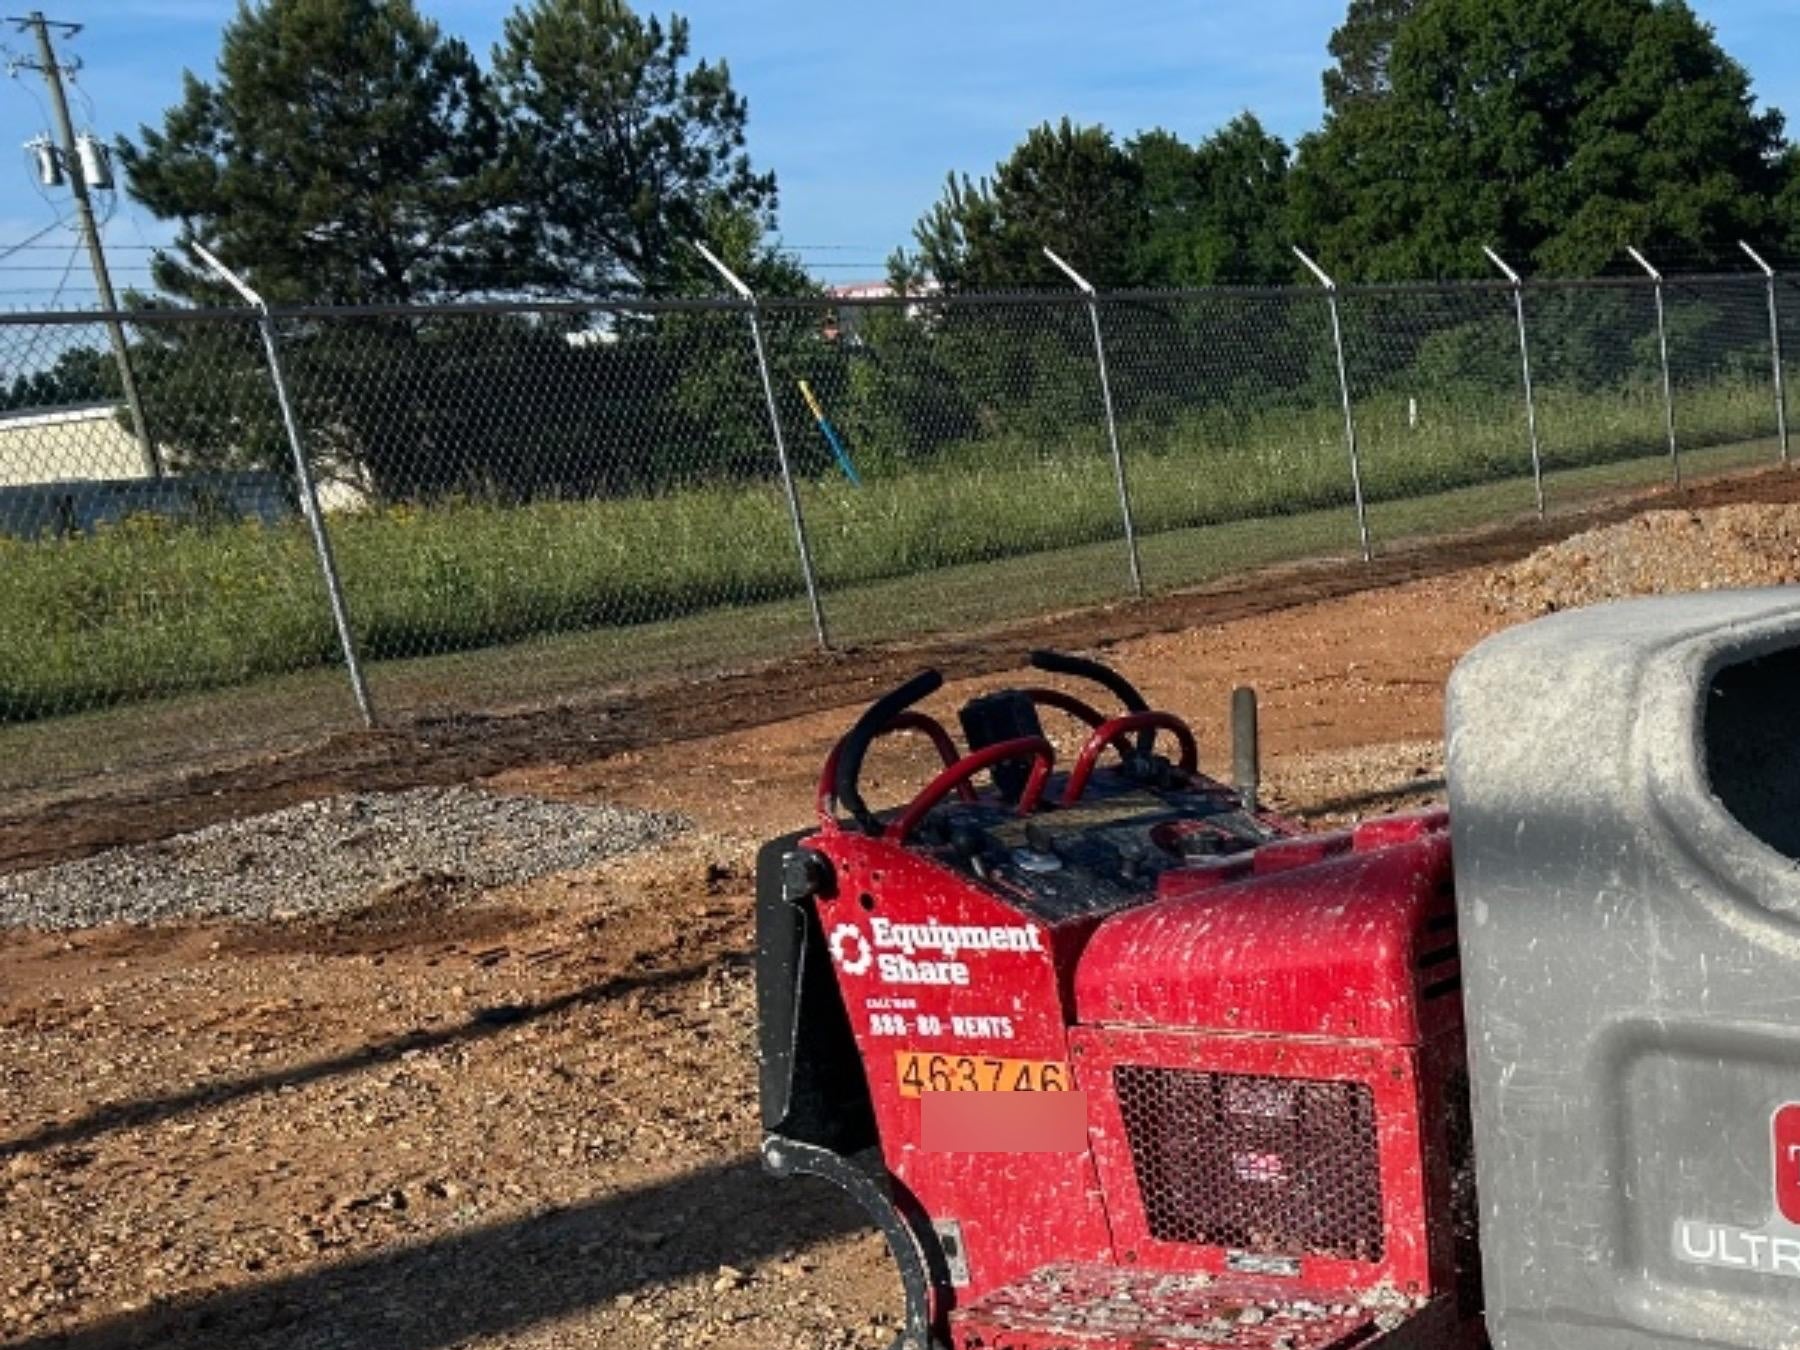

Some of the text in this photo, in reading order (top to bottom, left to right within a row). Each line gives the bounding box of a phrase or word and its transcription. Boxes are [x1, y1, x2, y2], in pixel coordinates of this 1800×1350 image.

[869, 916, 1044, 954] Equipment
[876, 953, 970, 985] Share
[902, 1054, 1063, 1092] 463746
